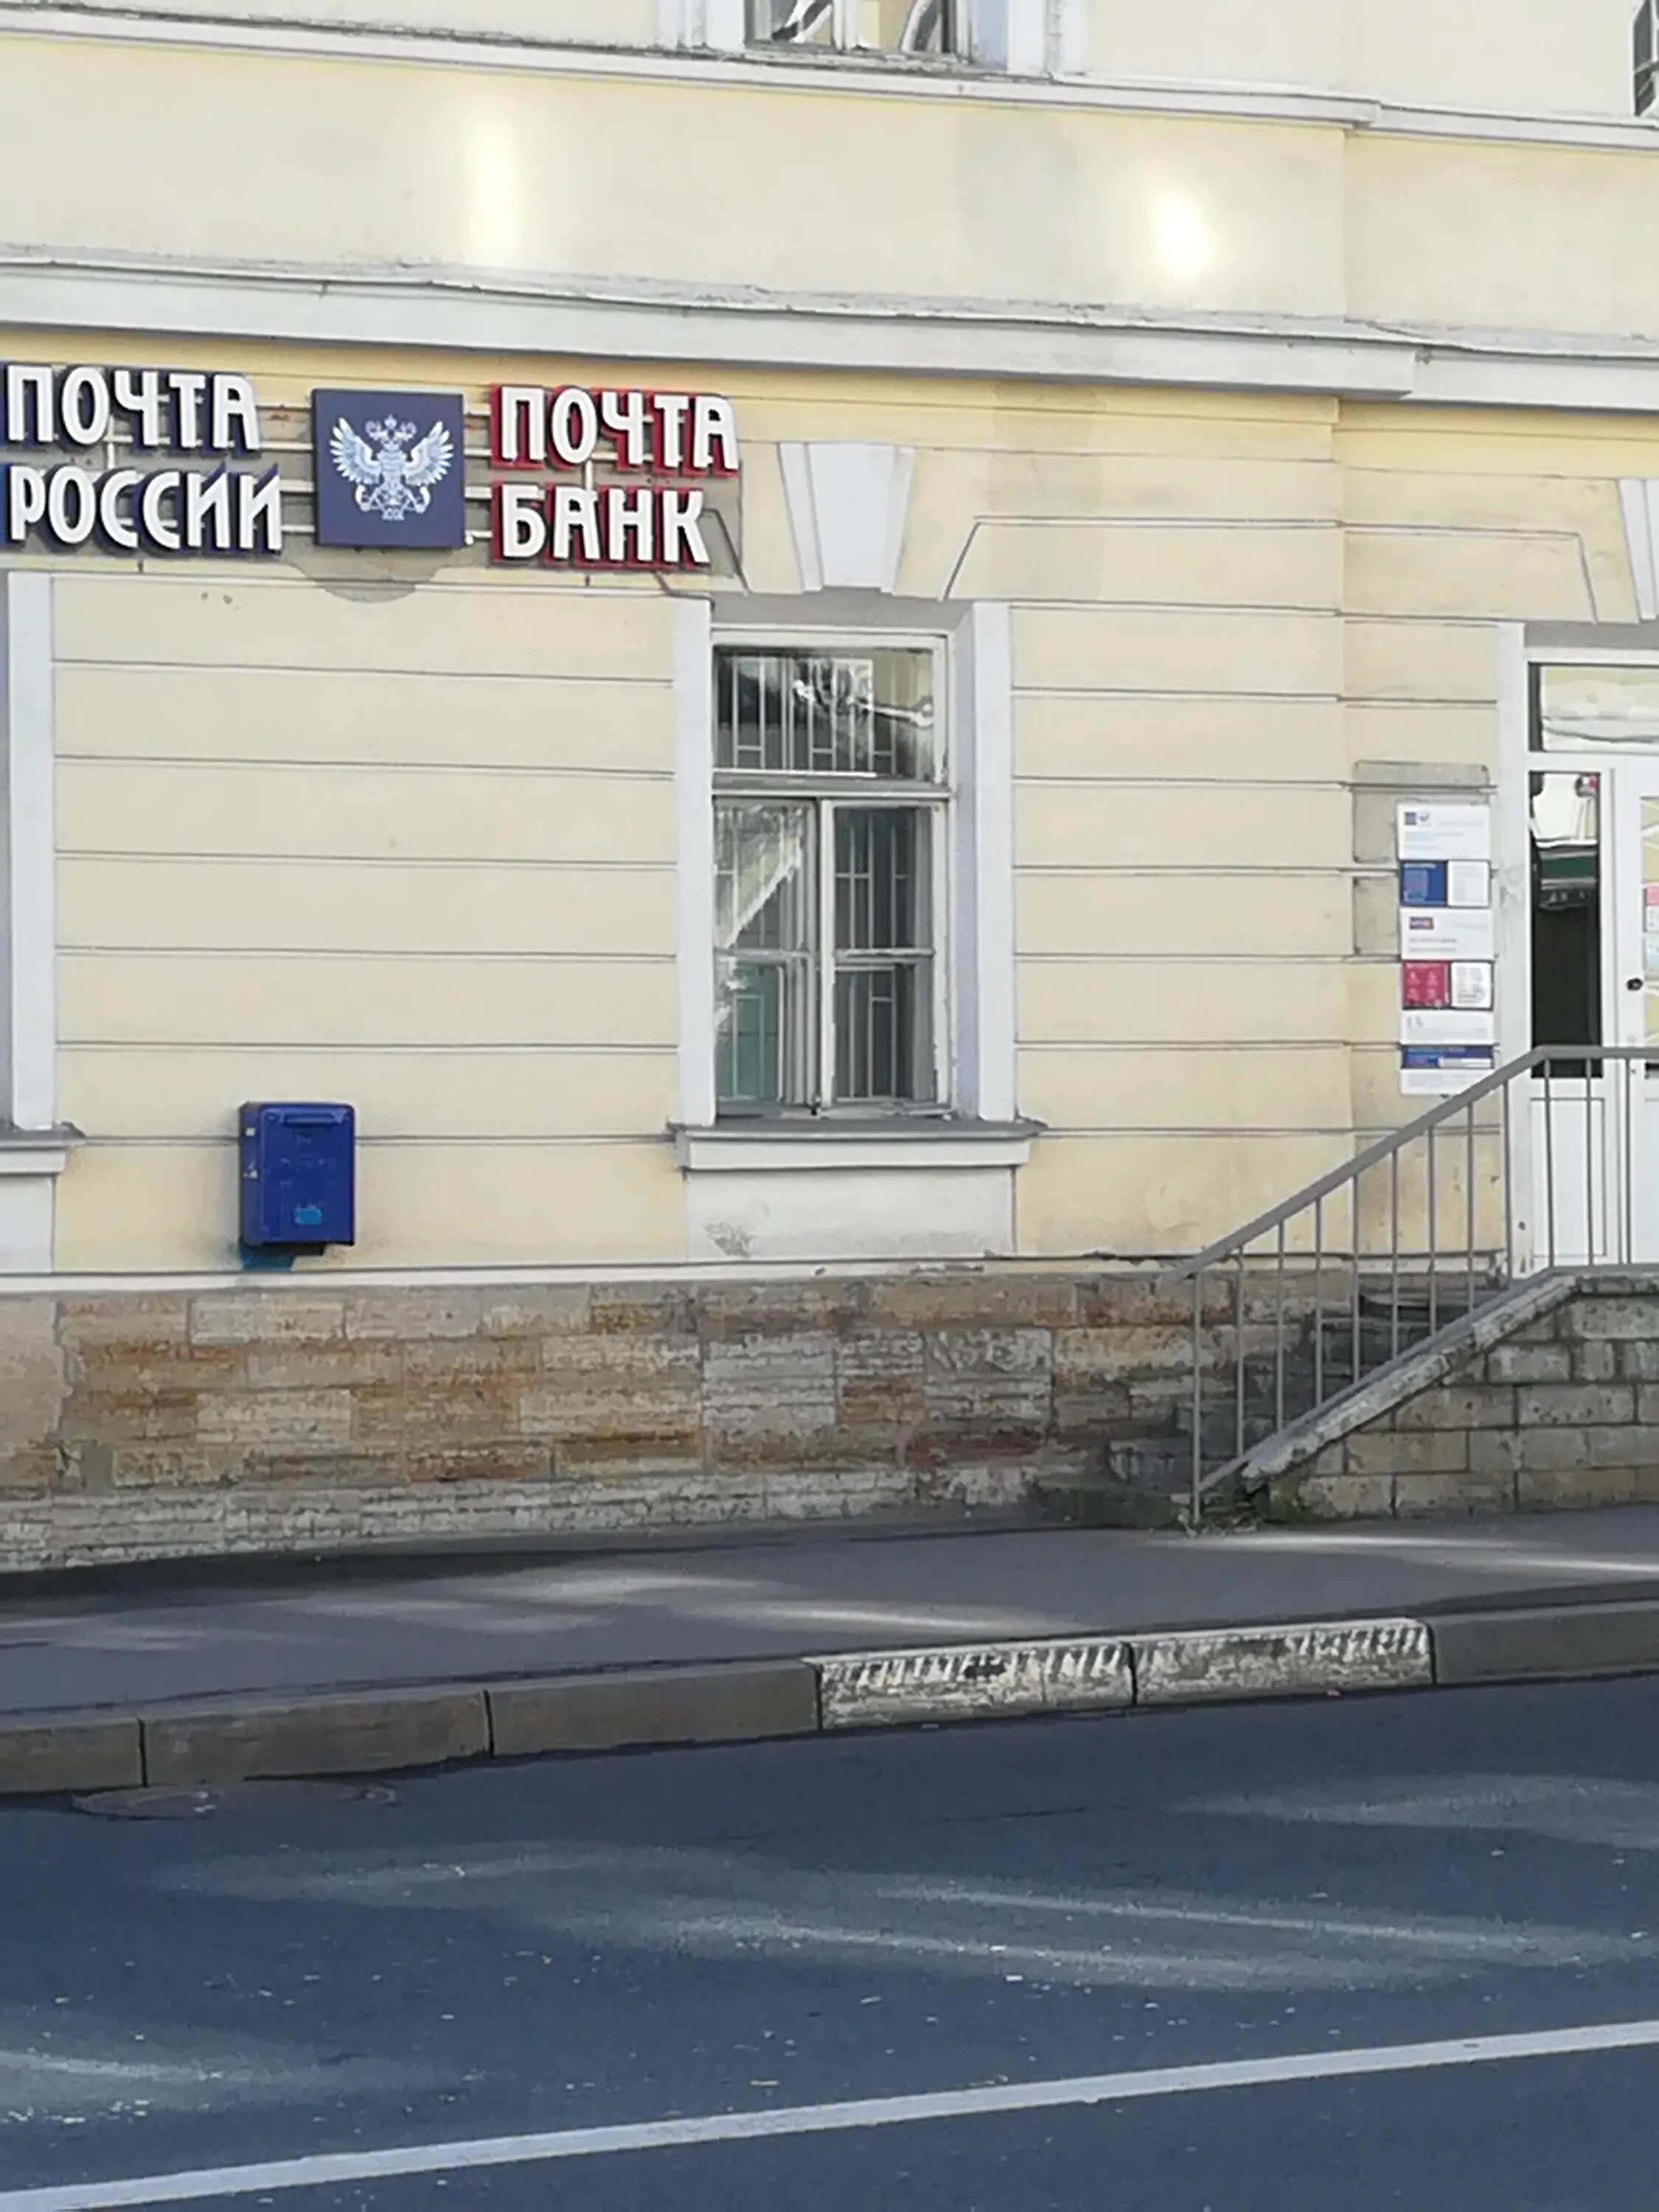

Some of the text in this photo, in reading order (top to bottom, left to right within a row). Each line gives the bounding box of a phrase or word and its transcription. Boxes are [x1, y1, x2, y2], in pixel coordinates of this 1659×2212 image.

[6, 364, 261, 451] ПОЧТА
[500, 386, 739, 471] ПОЧТА
[9, 465, 283, 551] РОССИИ
[501, 482, 711, 564] БАНК
